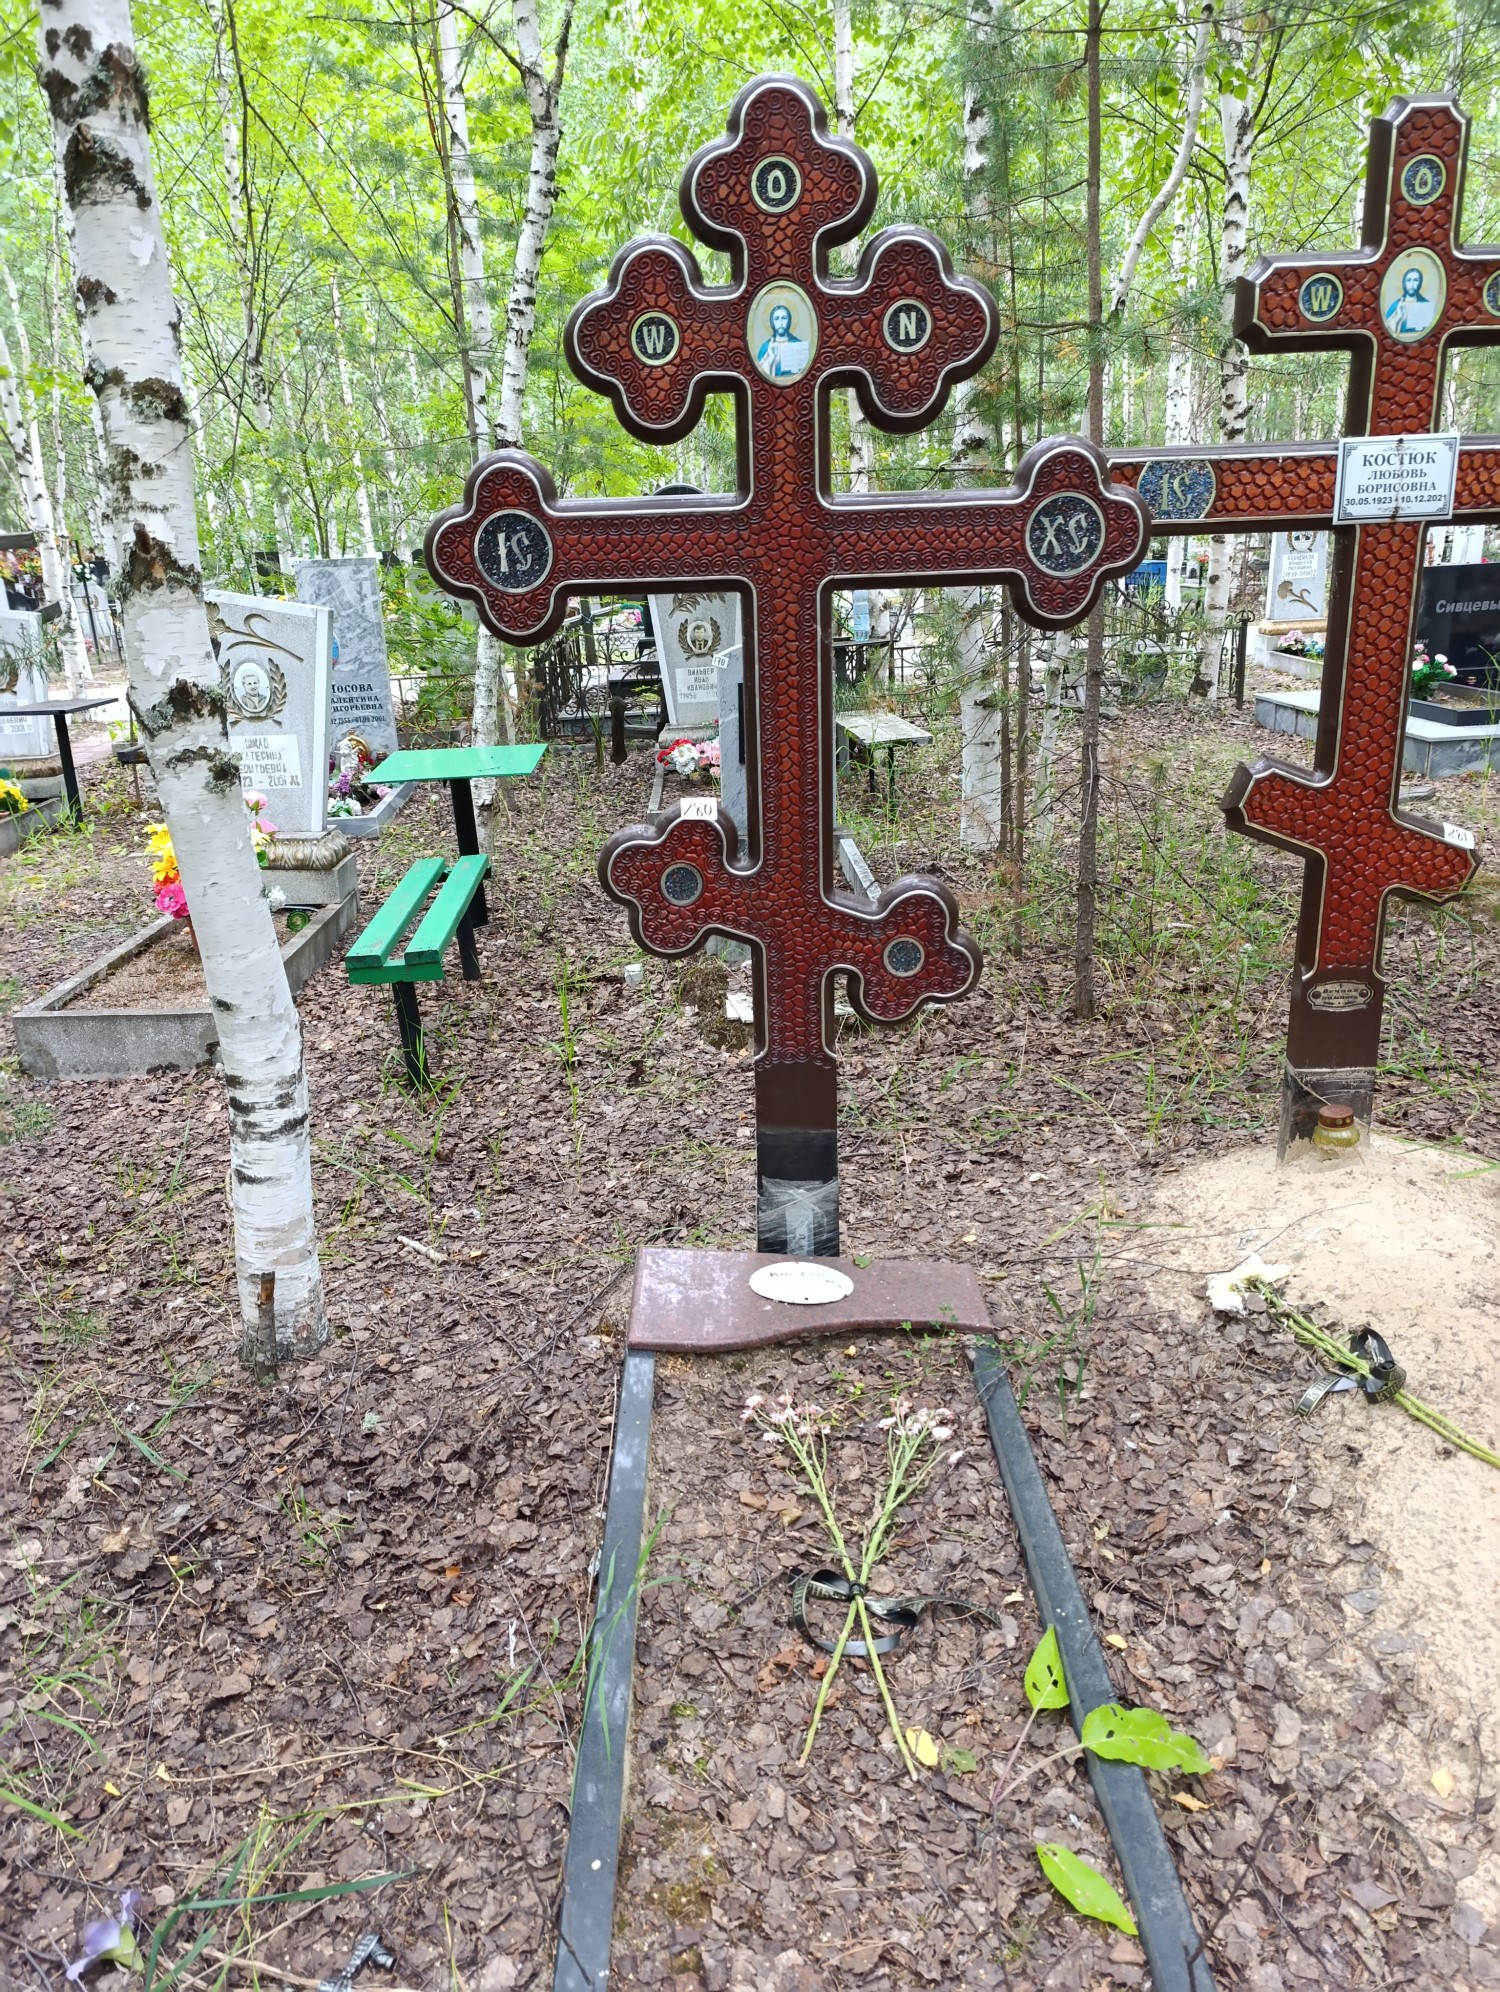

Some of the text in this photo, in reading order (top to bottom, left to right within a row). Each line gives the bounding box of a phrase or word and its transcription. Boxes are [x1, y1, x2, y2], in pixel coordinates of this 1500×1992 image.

[899, 311, 917, 340] N
[1362, 451, 1438, 467] КОСТЮК
[1367, 468, 1428, 480] ЛЮБОВЬ
[1356, 481, 1437, 494] БОРИСОВНА
[1345, 496, 1393, 506] 30.05.1923
[1401, 494, 1447, 503] 10.12.2021
[331, 695, 380, 704] АЛЕНТИНА
[331, 703, 384, 712] ИГОРЬЕВНА
